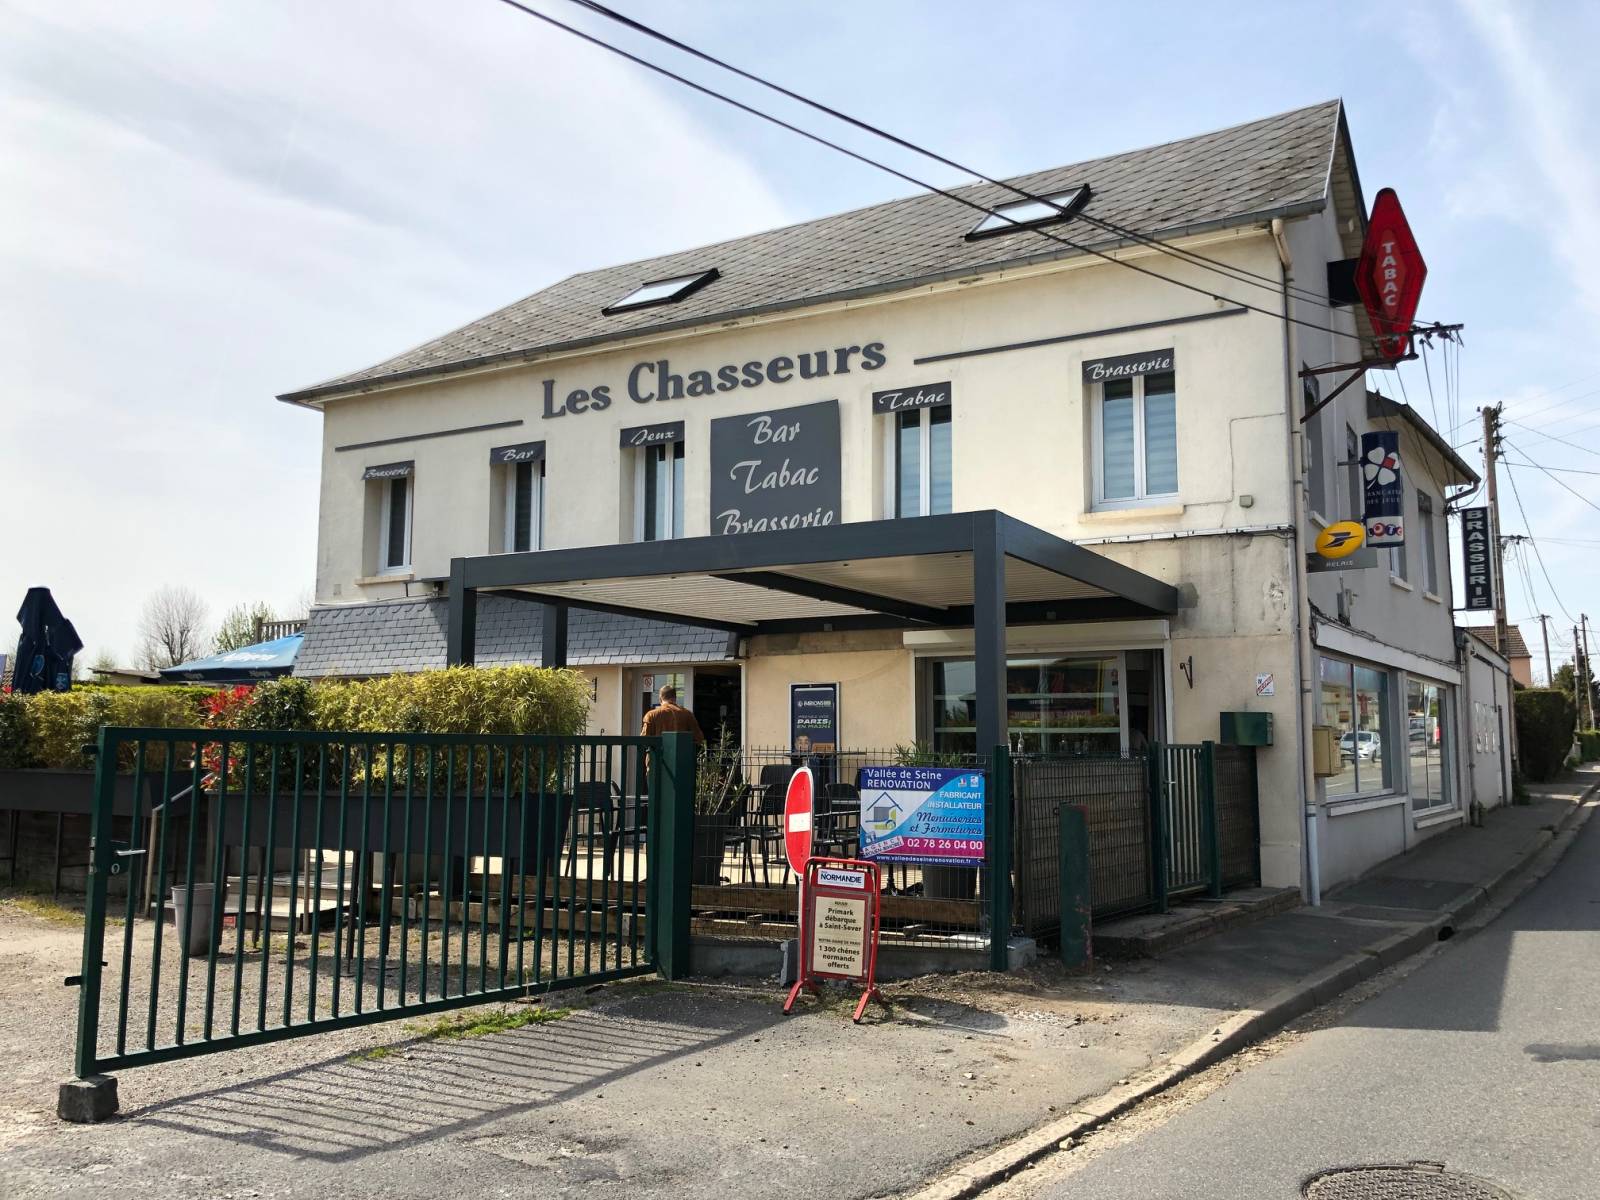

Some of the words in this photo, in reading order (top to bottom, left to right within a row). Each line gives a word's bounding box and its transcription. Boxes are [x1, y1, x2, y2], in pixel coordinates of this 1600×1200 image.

[1381, 241, 1398, 307] TABAC
[1086, 356, 1171, 381] Brasserie
[541, 378, 612, 420] Les
[627, 340, 888, 405] Chasseurs
[878, 389, 945, 411] Tabac
[746, 415, 801, 446] Bar
[630, 428, 676, 446] Jeux
[500, 448, 534, 462] Bar
[365, 466, 411, 480] Brasserie
[729, 458, 819, 495] Tabac
[716, 507, 834, 536] Brasserie
[1465, 509, 1488, 608] BRASSERIE
[867, 768, 897, 778] Vallée
[900, 769, 911, 779] de
[915, 770, 942, 780] Seine
[867, 779, 931, 790] RENOVATION
[939, 791, 982, 799] FABRICANT
[927, 802, 982, 810] INSTALLATEUR
[909, 823, 919, 832] et
[920, 822, 982, 835] Fermetures
[907, 838, 920, 848] 02
[923, 838, 936, 848] 78
[938, 839, 952, 849] 26
[954, 840, 967, 850] 04
[969, 840, 983, 850] 00
[821, 873, 862, 883] NORMANDIE
[827, 907, 854, 916] Primark
[825, 915, 857, 925] débarque
[824, 922, 862, 932] Saint-Sever
[823, 945, 836, 953] 300
[822, 953, 856, 962] normands
[827, 961, 850, 969] offerts
